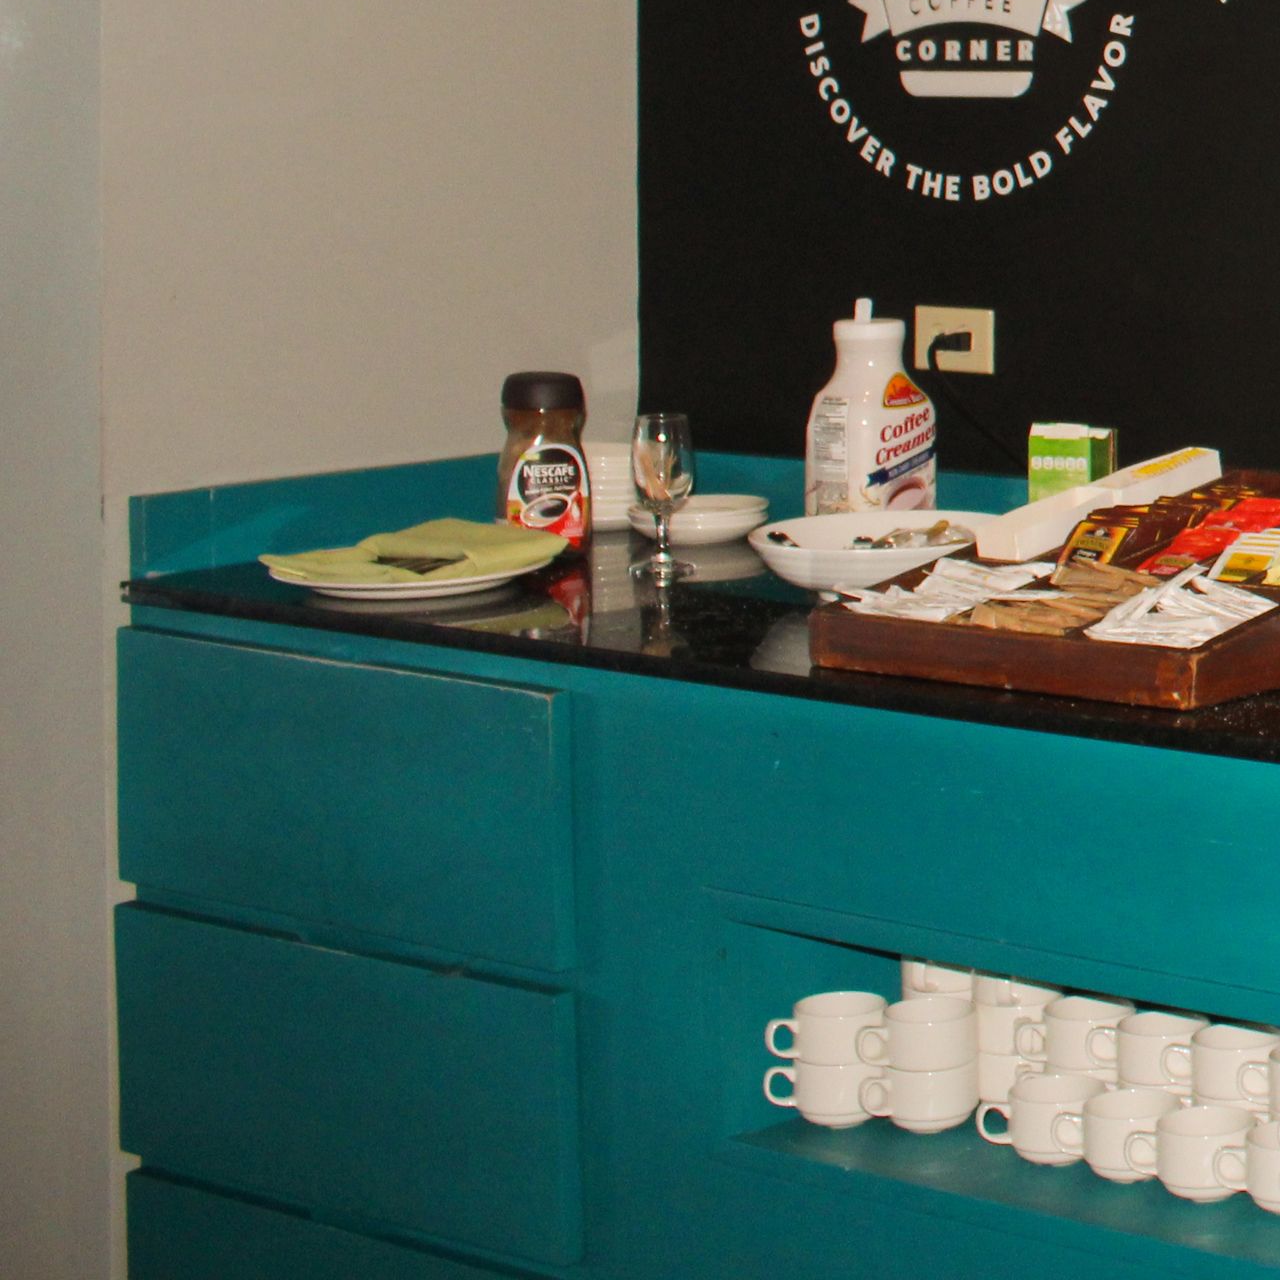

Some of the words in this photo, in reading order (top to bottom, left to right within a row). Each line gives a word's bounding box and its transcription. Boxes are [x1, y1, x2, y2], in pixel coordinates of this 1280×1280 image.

[896, 38, 1034, 62] CORNER
[799, 12, 897, 178] DISCOVER
[905, 163, 961, 202] THE
[971, 149, 1053, 202] BOLD
[1054, 12, 1135, 155] FLAVOR
[880, 407, 930, 444] Coffee
